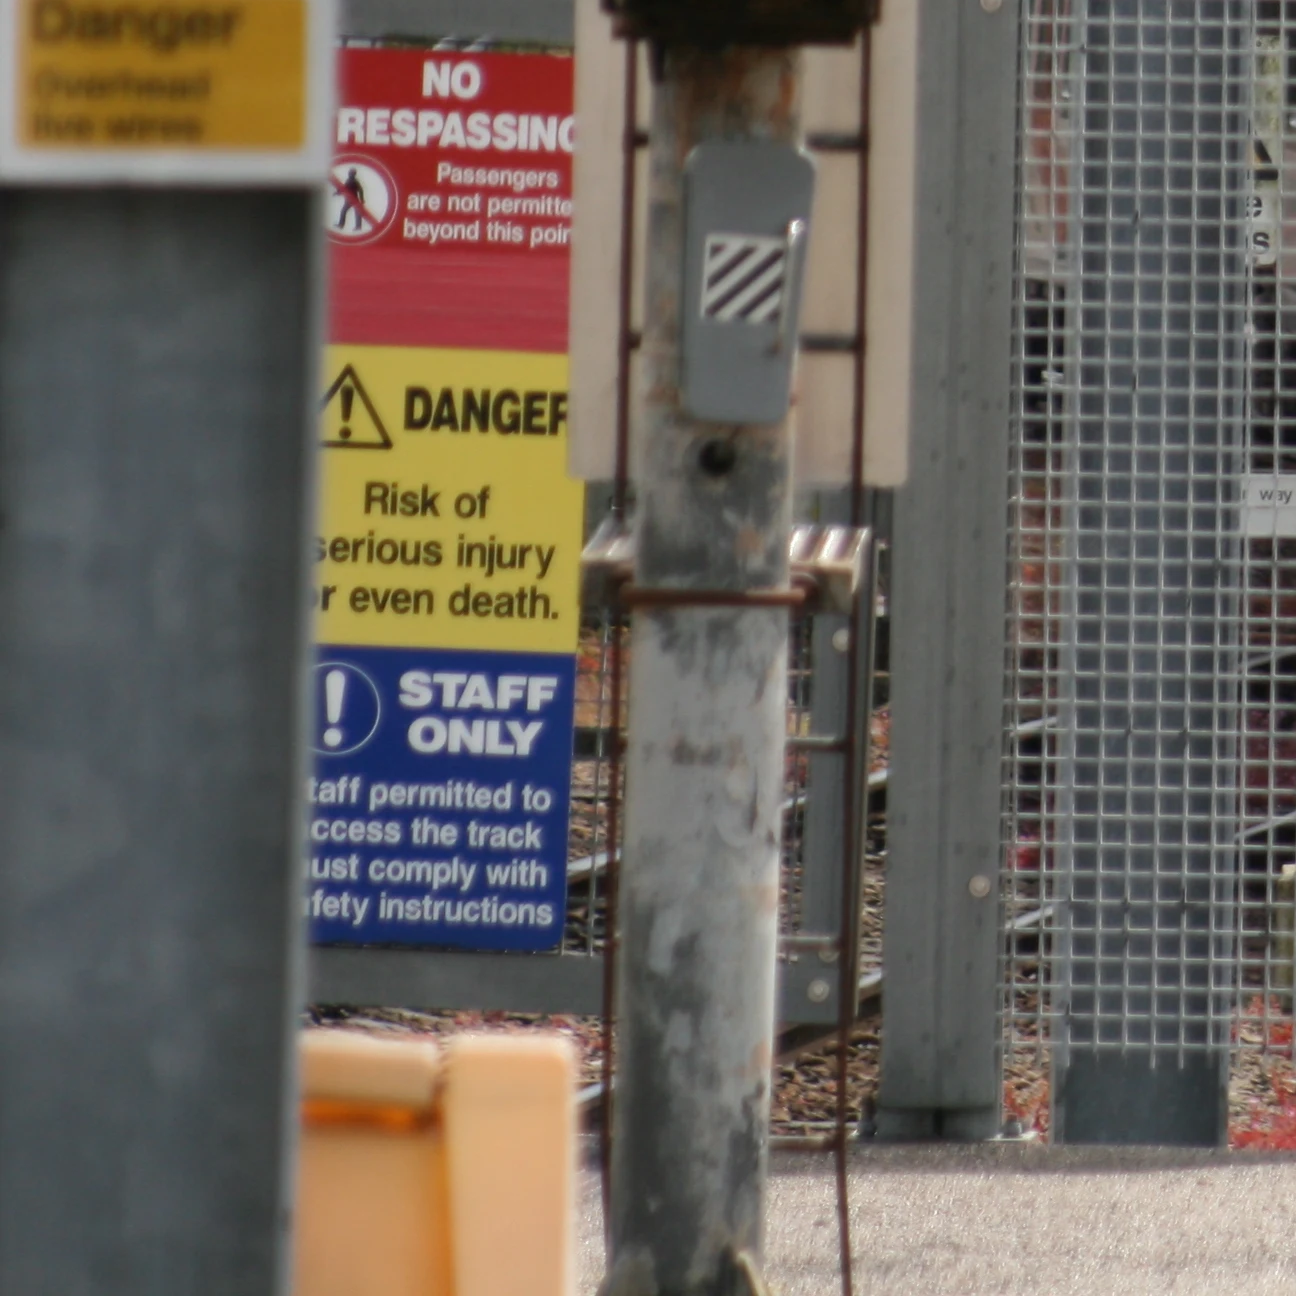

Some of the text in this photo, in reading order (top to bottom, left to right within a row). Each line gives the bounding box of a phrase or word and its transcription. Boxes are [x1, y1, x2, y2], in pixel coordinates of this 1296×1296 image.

[422, 60, 481, 99] NO
[336, 107, 575, 151] RESPASSING
[437, 162, 559, 192] Passengers
[407, 193, 572, 219] are not permitte
[403, 218, 480, 245] beyond
[487, 221, 524, 243] this
[364, 481, 492, 519] Risk of
[457, 533, 556, 579] injury
[349, 586, 435, 616] even
[448, 583, 559, 621] death.
[399, 669, 558, 712] STAFF
[407, 716, 543, 756] ONLY
[308, 776, 552, 812] taff permitted to
[309, 817, 542, 849] ccess the track
[307, 854, 548, 891] ust comply with
[308, 887, 554, 926] fety instructions
